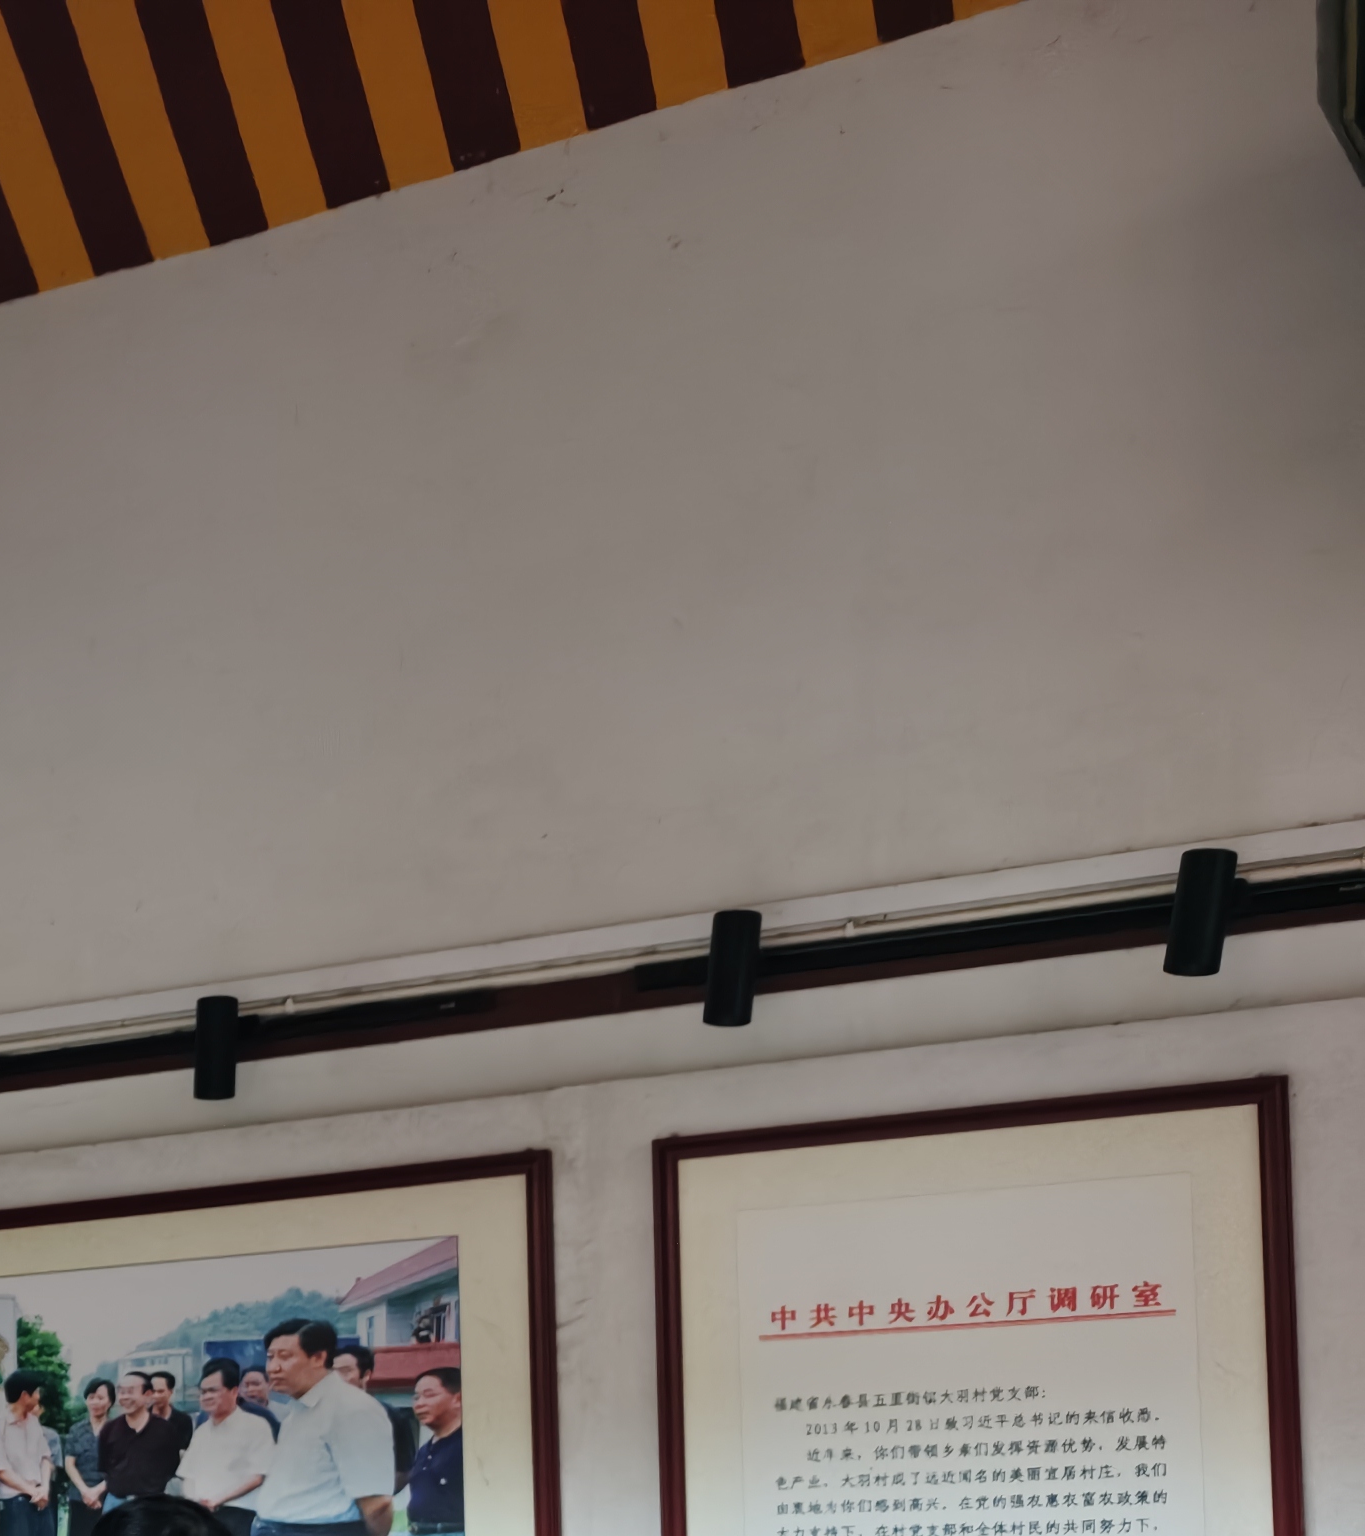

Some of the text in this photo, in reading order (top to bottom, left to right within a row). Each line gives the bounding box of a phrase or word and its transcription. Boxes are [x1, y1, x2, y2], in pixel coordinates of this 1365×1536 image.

[770, 1280, 1162, 1332] 中共中央办公厅调研室
